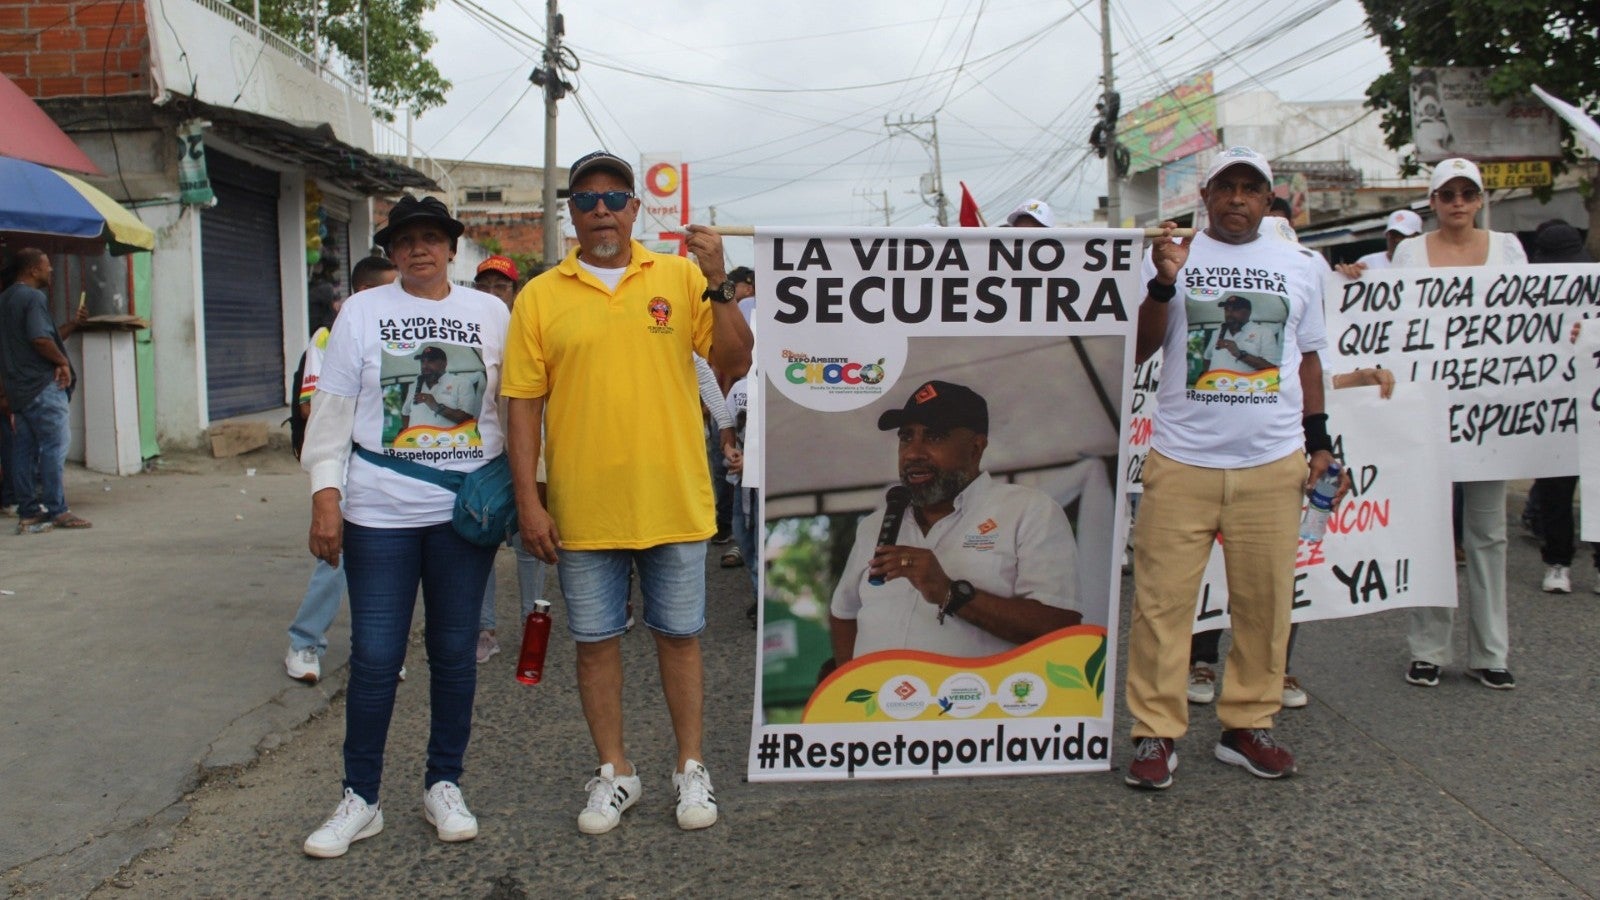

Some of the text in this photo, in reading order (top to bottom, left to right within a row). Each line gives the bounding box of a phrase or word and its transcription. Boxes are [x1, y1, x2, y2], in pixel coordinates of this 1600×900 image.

[773, 238, 1133, 271] LA VIDA NO SE
[1185, 267, 1287, 283] LA VIDA NO SE
[1185, 276, 1288, 295] SECUESTRA
[773, 276, 1129, 324] SECUESTRA
[1339, 280, 1405, 314] DIOS
[1416, 276, 1474, 308] TOCA
[379, 317, 481, 333] LA VIDA NO SE
[380, 326, 482, 345] SECUESTRA
[1338, 312, 1564, 356] QUE EL PERDON
[1186, 389, 1278, 406] #Respetoporlavida
[1449, 397, 1578, 446] ESPUESTA
[383, 446, 483, 463] #Respetoporlavida
[757, 722, 1109, 778] #Respetoporlavida
